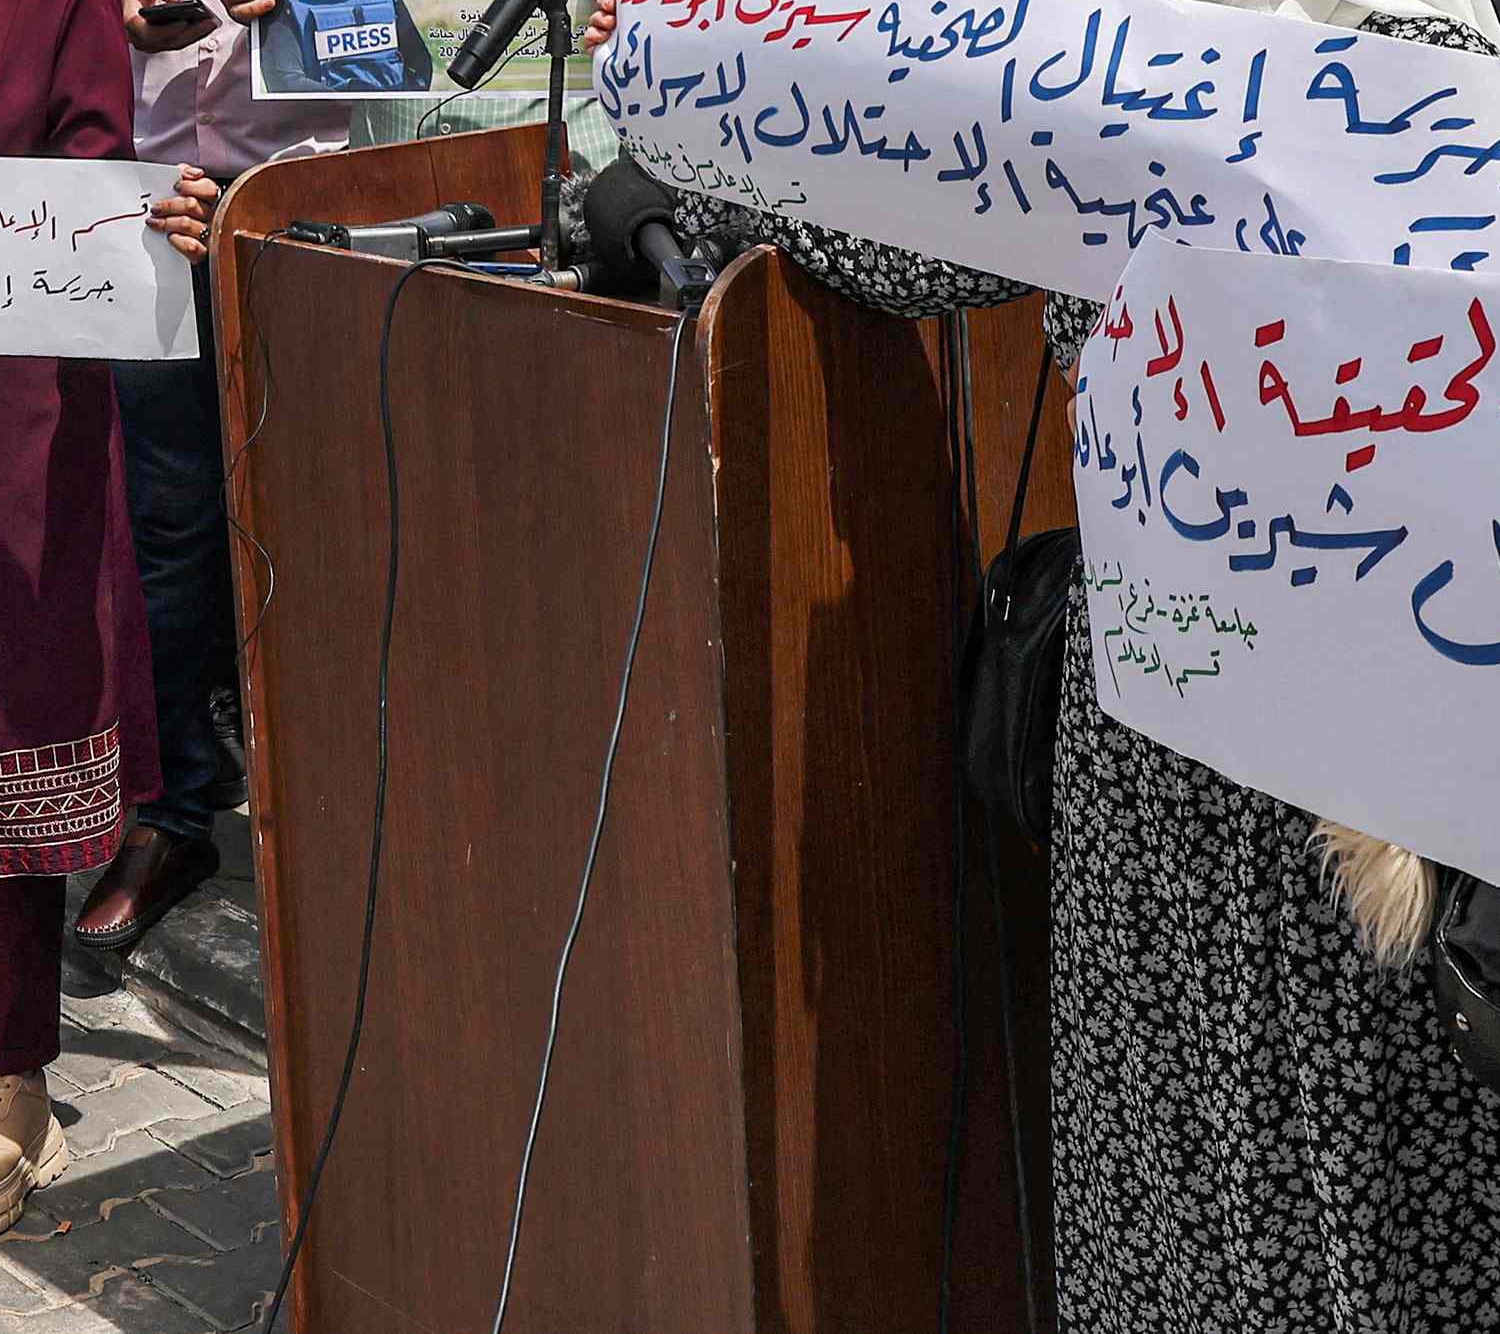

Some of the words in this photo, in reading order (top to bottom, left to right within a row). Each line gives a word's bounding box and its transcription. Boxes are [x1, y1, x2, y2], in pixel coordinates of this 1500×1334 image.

[325, 26, 393, 55] PRESS
[429, 28, 455, 41] جبانة
[71, 192, 152, 253] قسم
[31, 269, 116, 303] جريمة
[1158, 448, 1410, 589] شيرين
